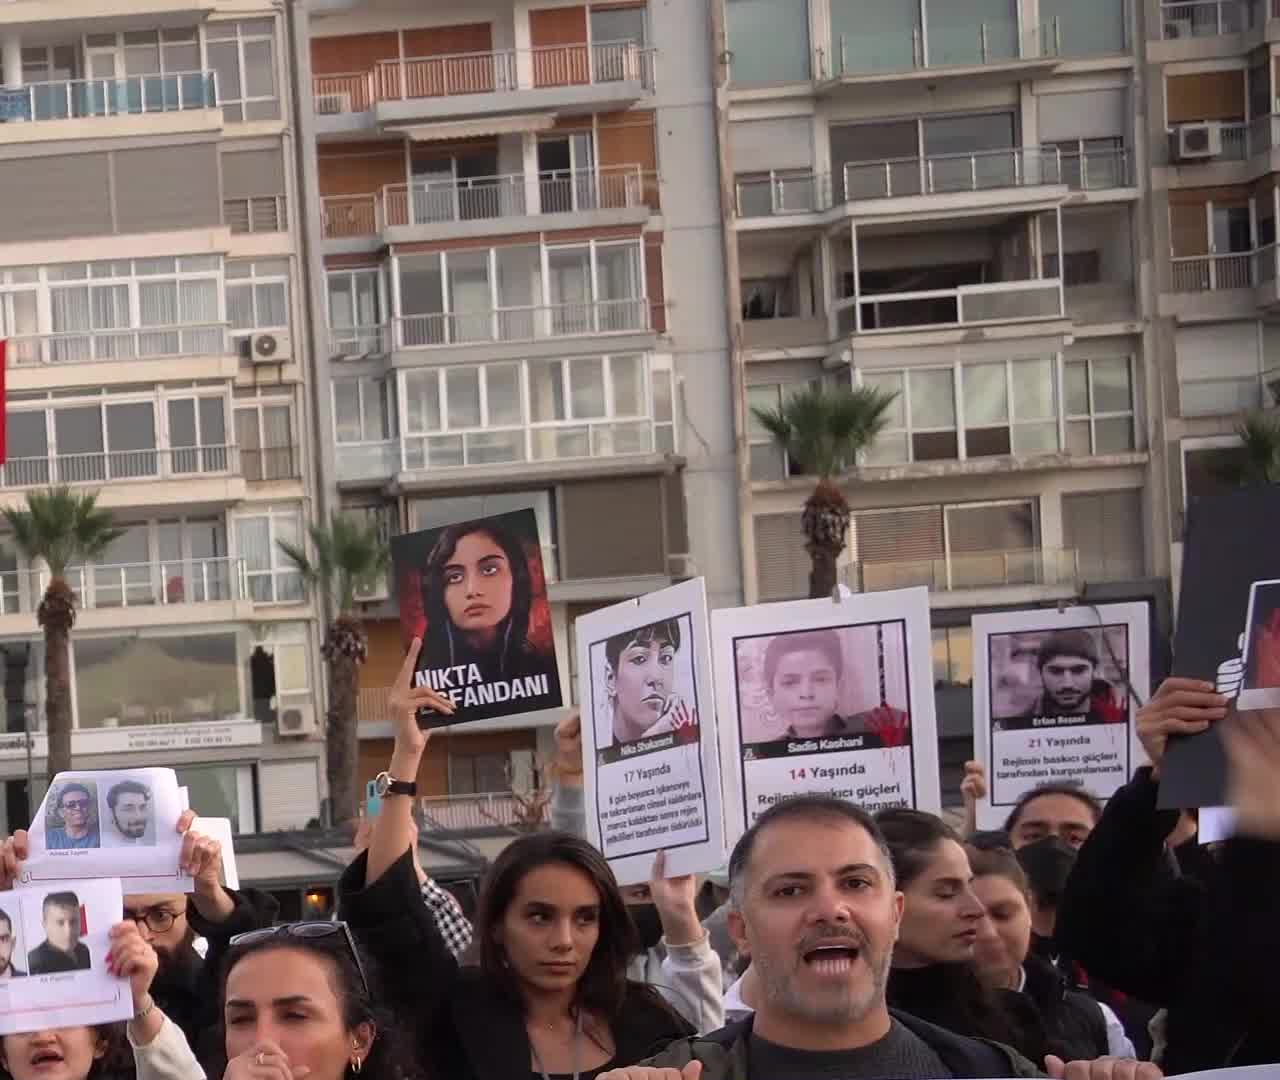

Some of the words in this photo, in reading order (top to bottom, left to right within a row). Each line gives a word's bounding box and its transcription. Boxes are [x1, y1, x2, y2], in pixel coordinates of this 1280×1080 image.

[414, 663, 482, 690] NIKTA
[421, 673, 549, 712] FANDANI
[1045, 735, 1091, 748] Yaşında
[624, 770, 635, 783] 17
[636, 763, 671, 781] Yaşında
[789, 768, 807, 780] 14
[809, 763, 866, 779] Yaşında
[856, 783, 901, 799] güçleri
